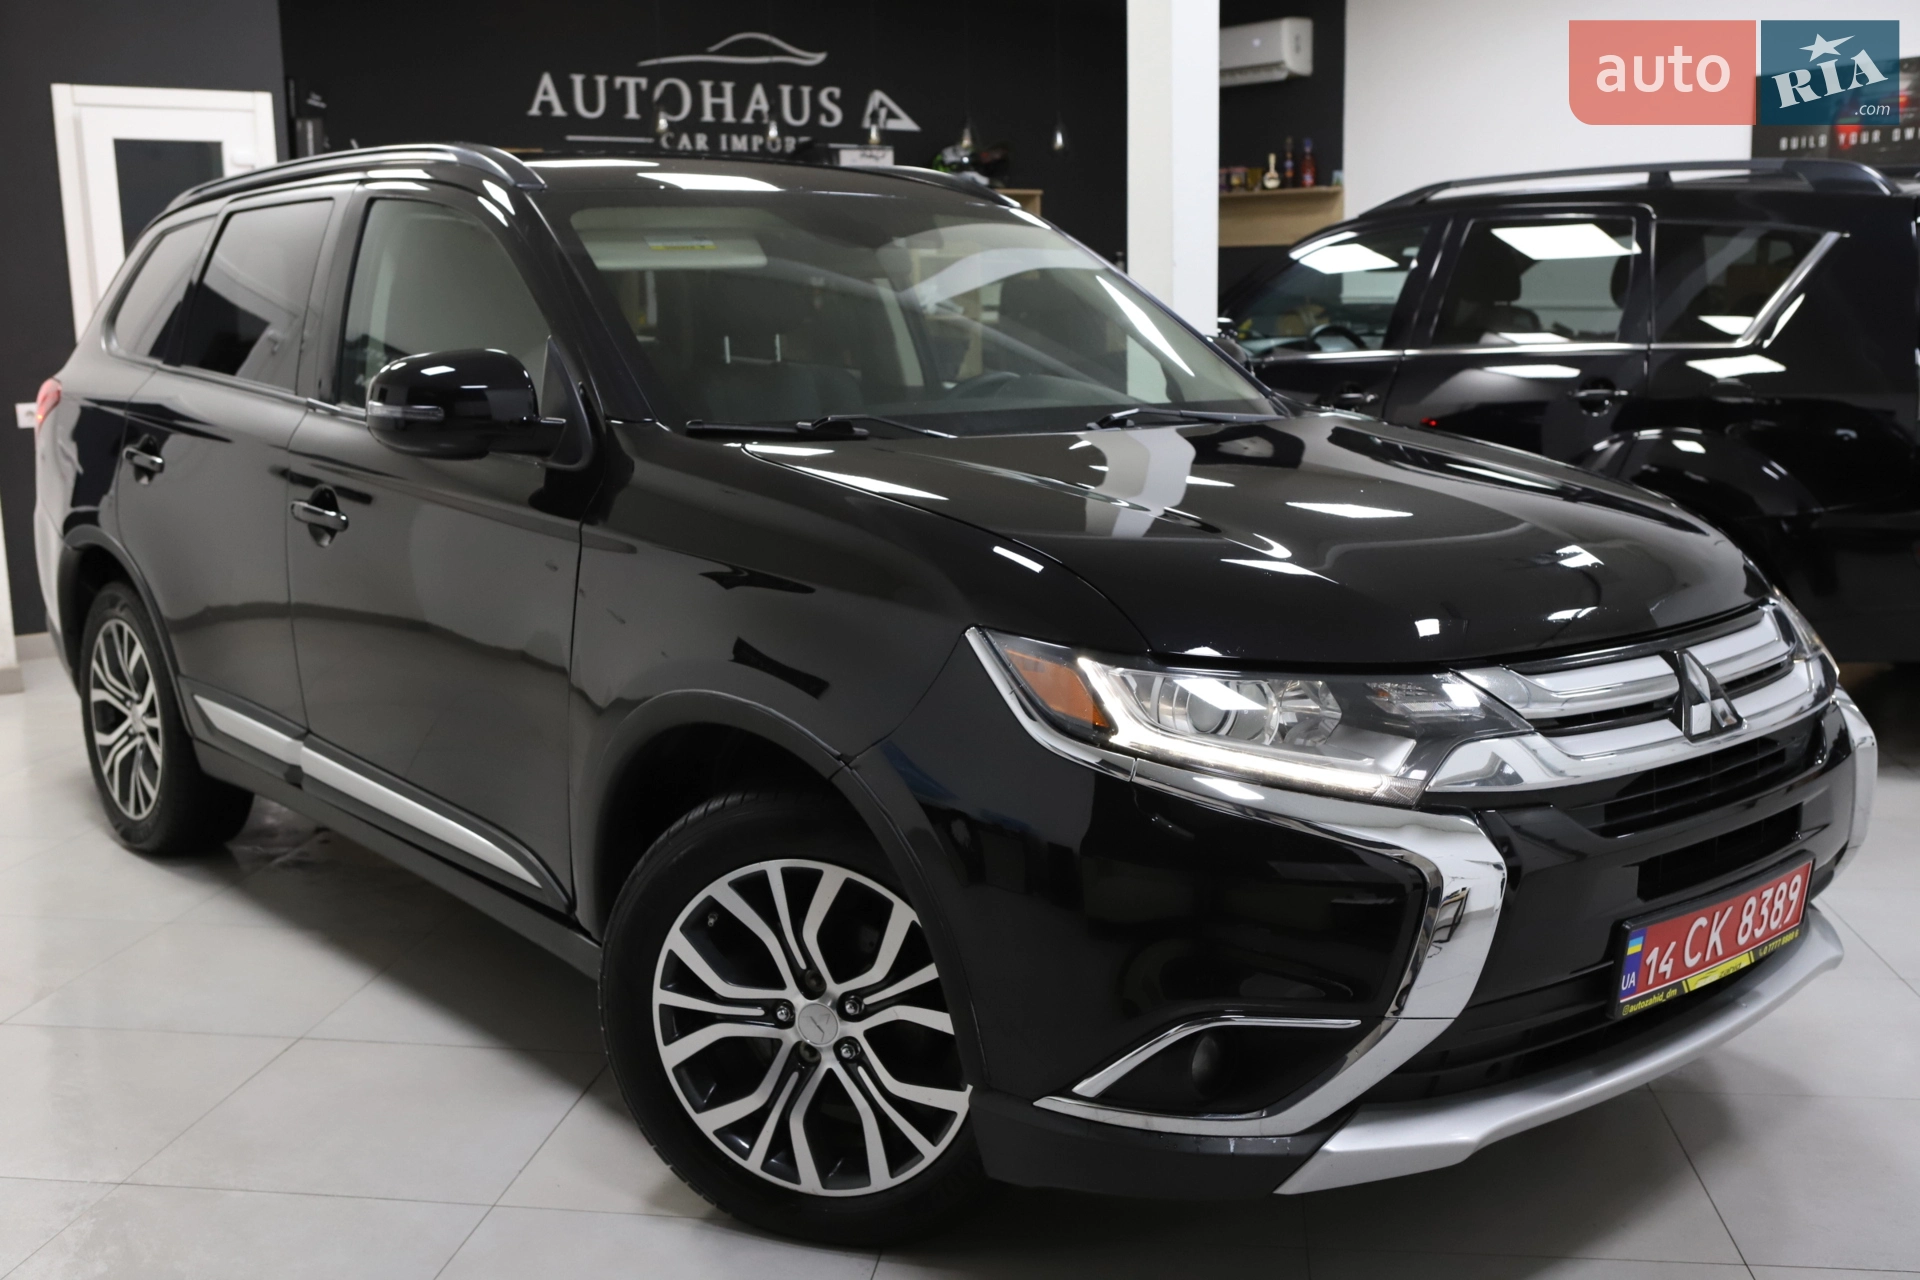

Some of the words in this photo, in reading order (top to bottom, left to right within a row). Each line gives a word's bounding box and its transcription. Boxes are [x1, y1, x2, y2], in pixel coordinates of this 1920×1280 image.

[527, 72, 843, 127] AUTOHAUS
[660, 132, 709, 151] CAR
[1779, 134, 1828, 151] BUILD
[1838, 129, 1881, 146] YOUR
[1892, 127, 1920, 142] OW
[1646, 941, 1677, 986] 14
[1684, 905, 1734, 968] CK
[1737, 873, 1803, 946] 8389
[1621, 971, 1636, 991] UA
